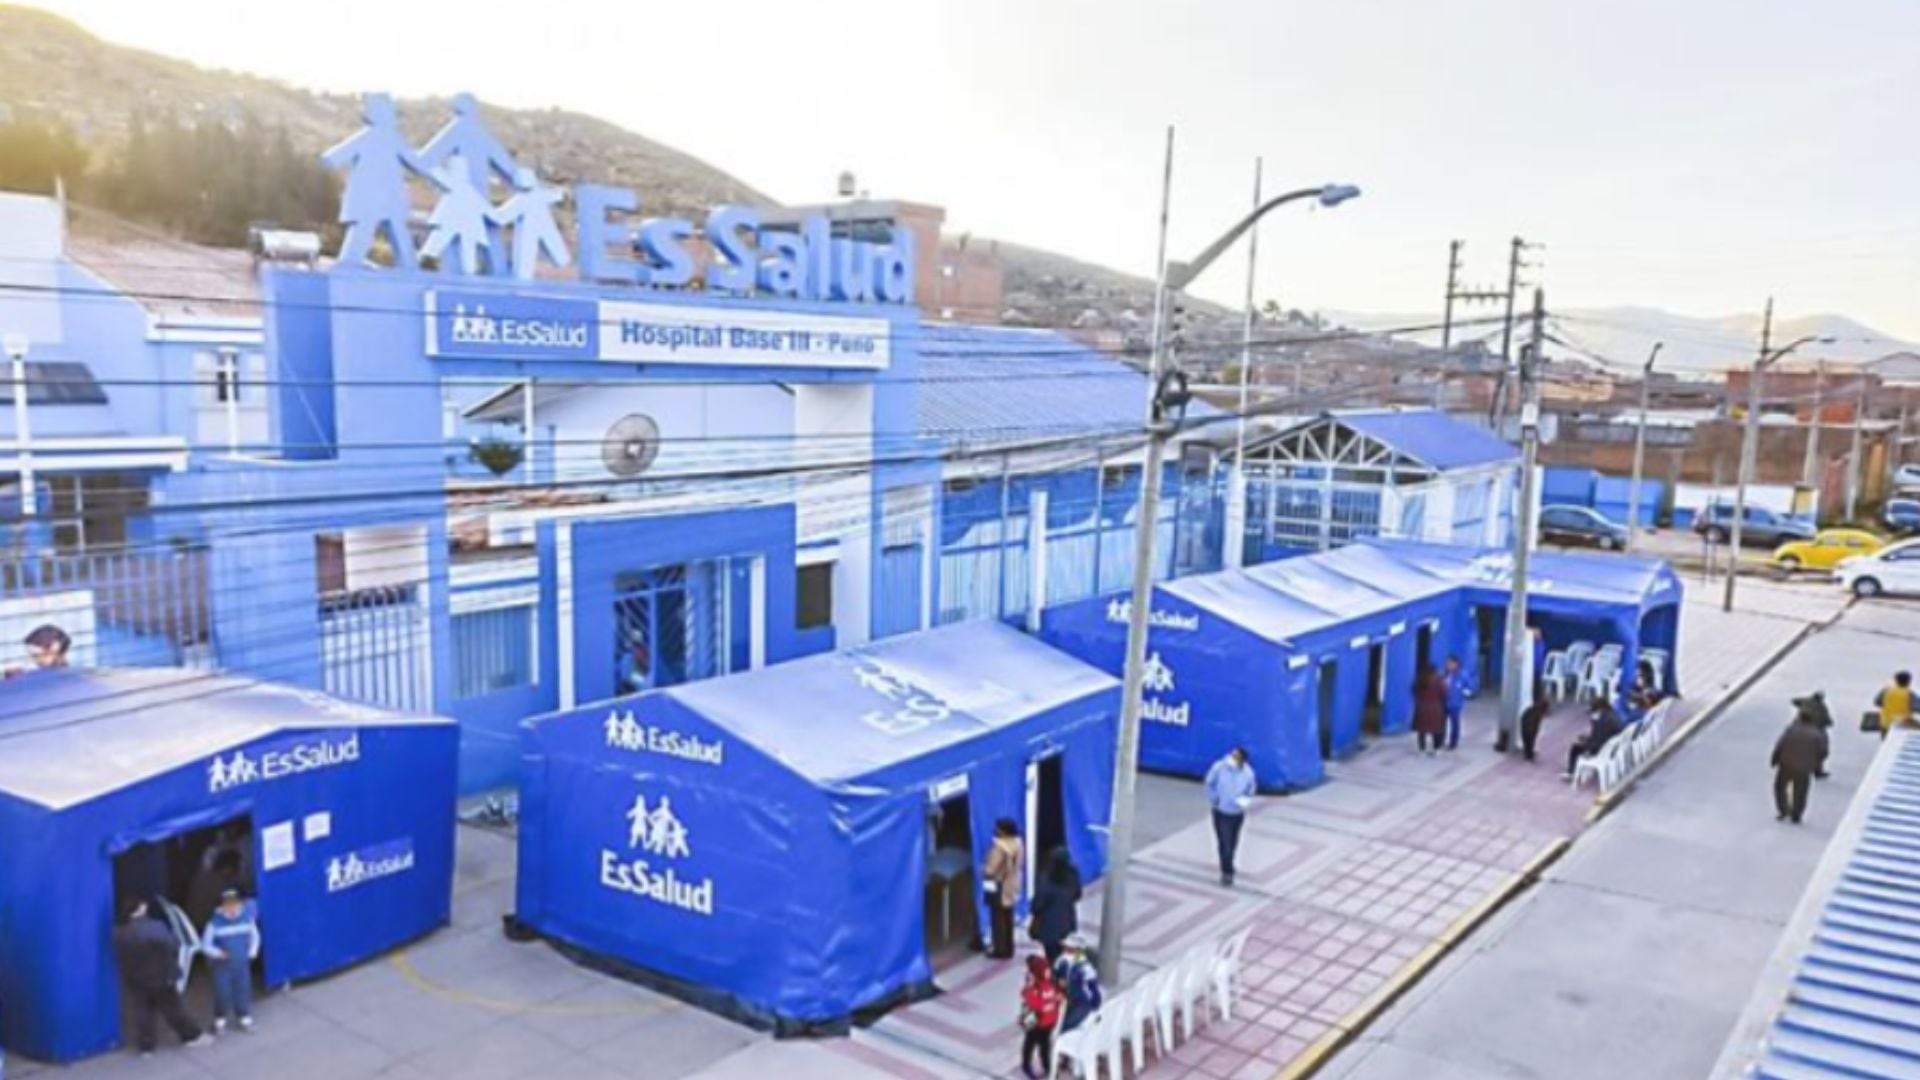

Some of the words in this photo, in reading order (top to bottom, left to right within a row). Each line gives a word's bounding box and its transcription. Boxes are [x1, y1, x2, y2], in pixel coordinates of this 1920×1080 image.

[502, 318, 588, 348] EsSalud
[620, 320, 722, 350] Hospital
[729, 327, 782, 350] Base
[261, 731, 360, 779] EsSalud
[647, 726, 723, 764] EsSalud
[600, 848, 713, 915] EsSalud
